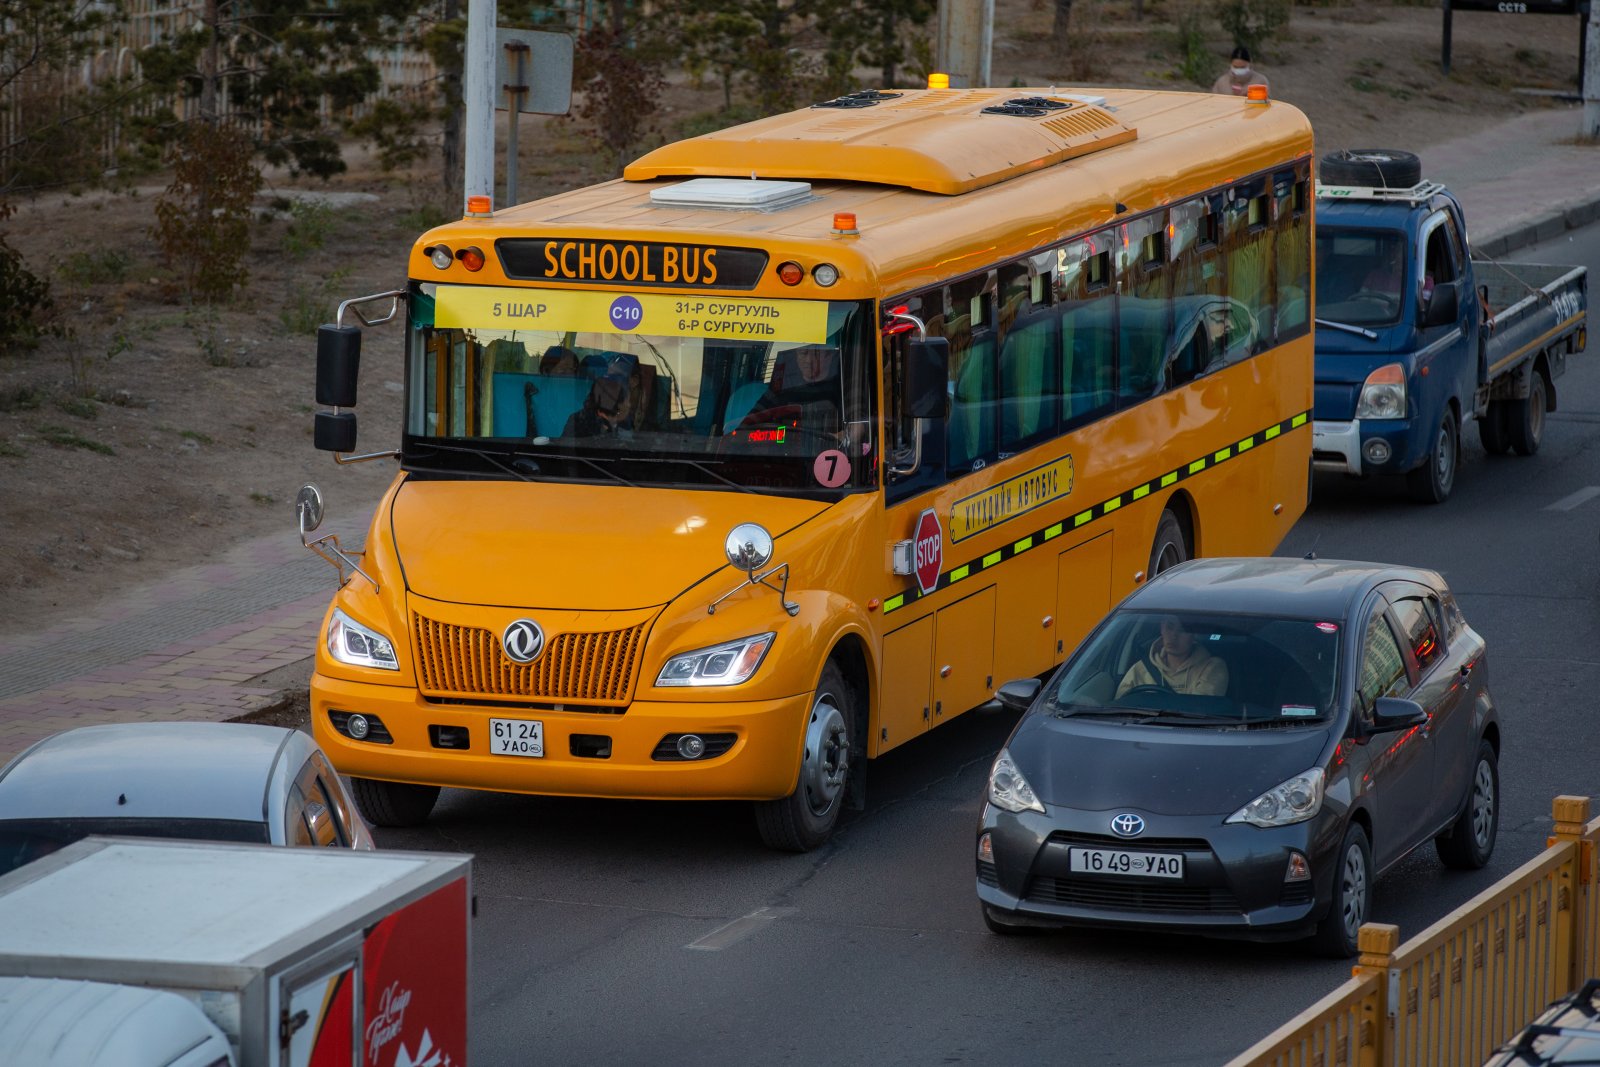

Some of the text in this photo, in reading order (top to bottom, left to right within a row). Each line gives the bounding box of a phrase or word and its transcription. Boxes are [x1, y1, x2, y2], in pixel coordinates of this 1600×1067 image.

[544, 241, 717, 284] SCHOOL BUS
[493, 303, 547, 318] 5 ШАР
[675, 302, 780, 318] 31-Р СУРГУУЛЬ
[678, 319, 775, 335] 6-Р СУРГУУЛЬ
[824, 455, 838, 482] 7
[1018, 468, 1058, 509] АВТОБУС
[917, 534, 940, 569] STOP
[502, 740, 528, 752] УАО
[1145, 855, 1180, 875] УАО
